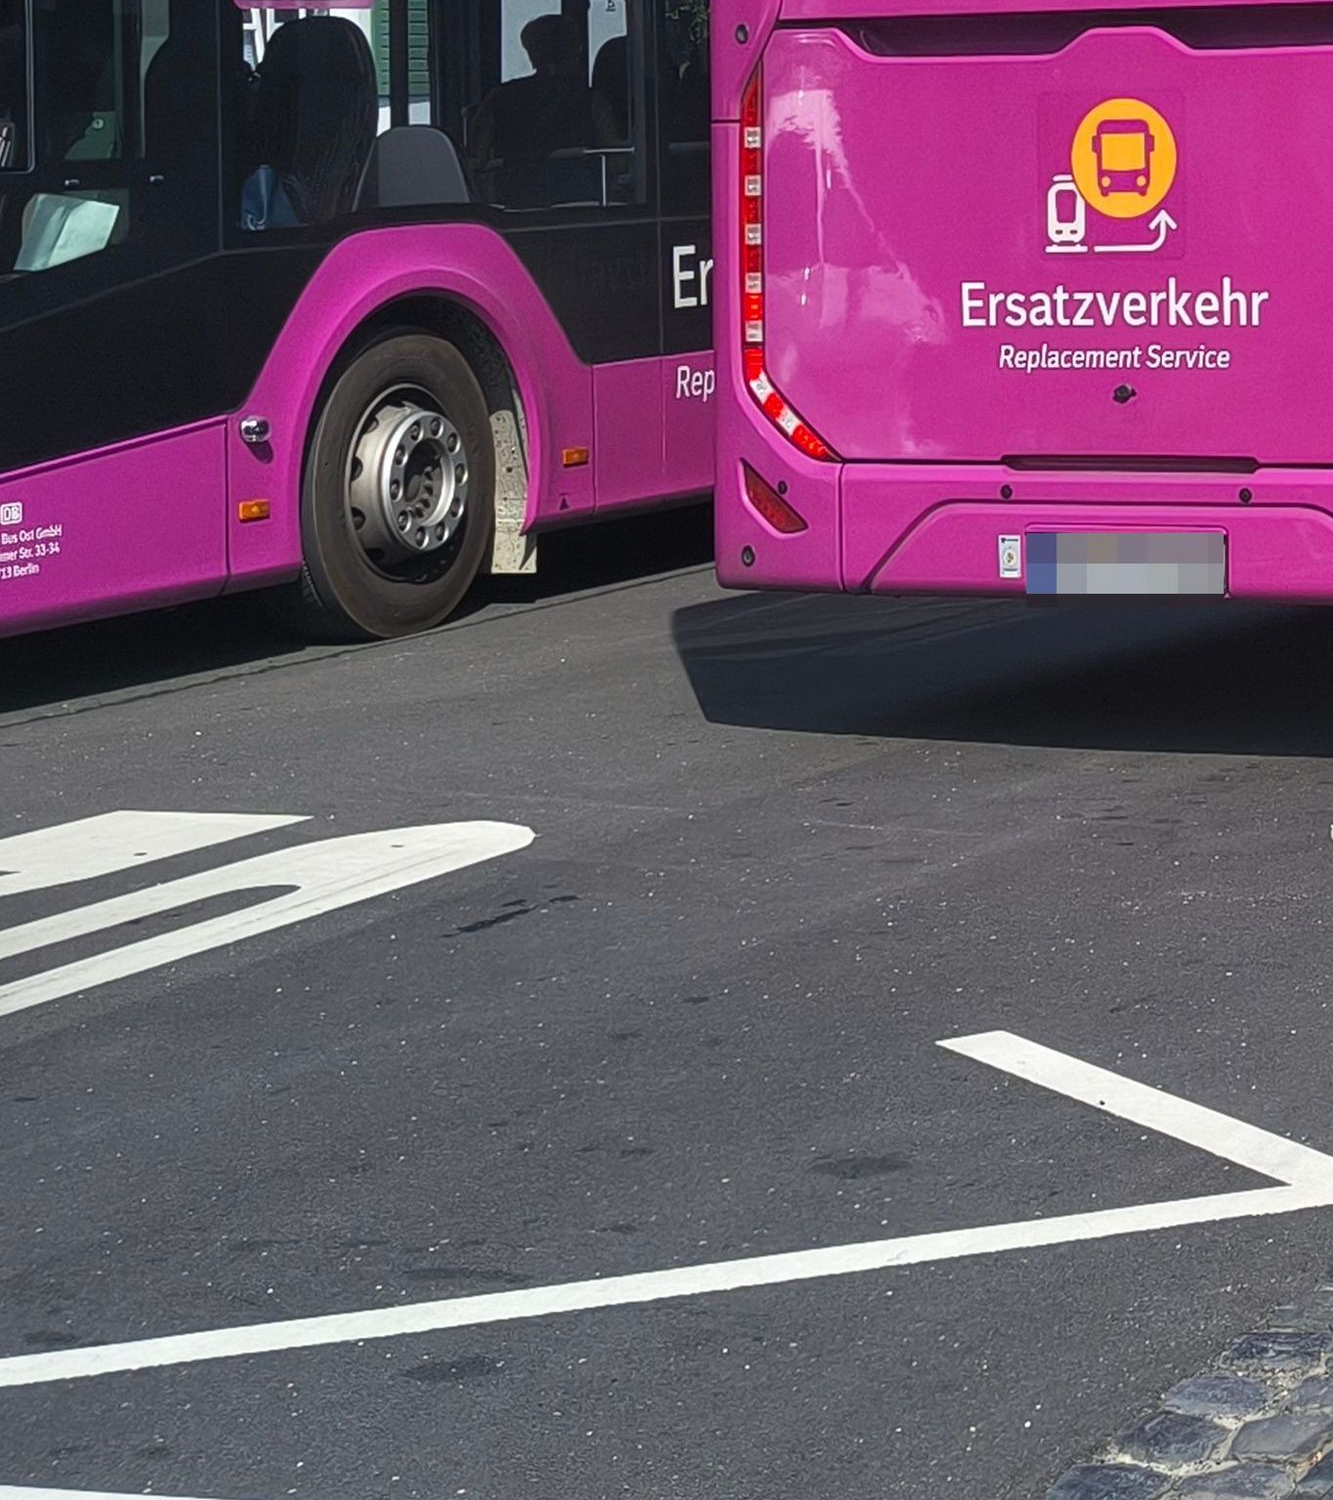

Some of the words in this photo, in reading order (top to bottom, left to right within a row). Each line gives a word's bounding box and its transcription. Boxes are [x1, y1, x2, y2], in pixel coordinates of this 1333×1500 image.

[672, 244, 714, 309] Er
[961, 276, 1269, 327] Ersatzverkehr
[999, 343, 1142, 373] Replacement
[1145, 344, 1230, 369] Service
[676, 365, 716, 403] Rep
[0, 565, 12, 579] 13
